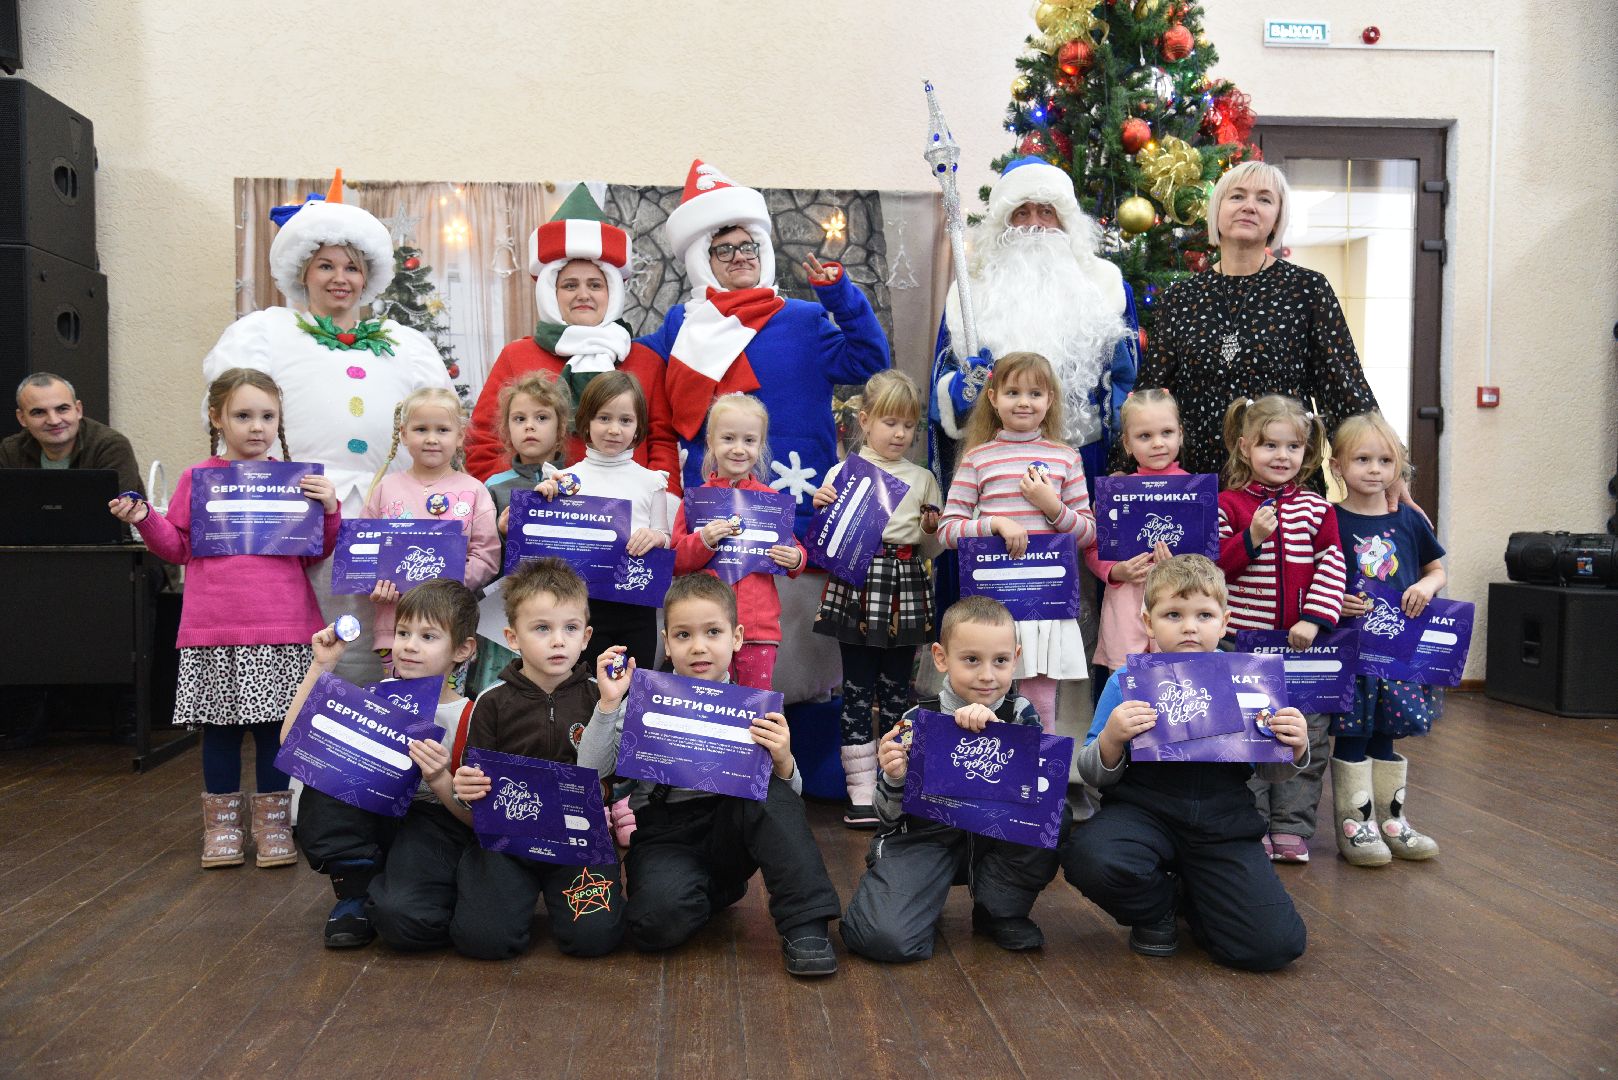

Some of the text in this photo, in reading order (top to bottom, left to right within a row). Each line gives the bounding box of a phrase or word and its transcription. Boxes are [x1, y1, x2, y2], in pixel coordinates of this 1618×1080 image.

[1270, 24, 1323, 40] ВЫХОД
[210, 484, 301, 494] СЕРТИФИКАТ
[1112, 493, 1198, 502] СЕРТИФИКАТ
[528, 508, 613, 523] СЕРТИФИКАТ
[817, 474, 857, 546] СЕРТИФИКАТ
[718, 544, 770, 556] СЕРТИФИ
[1253, 646, 1338, 654] СЕРТИИКАТ
[652, 694, 757, 720] СЕРТИФИКАТ
[574, 887, 603, 900] SPORT
